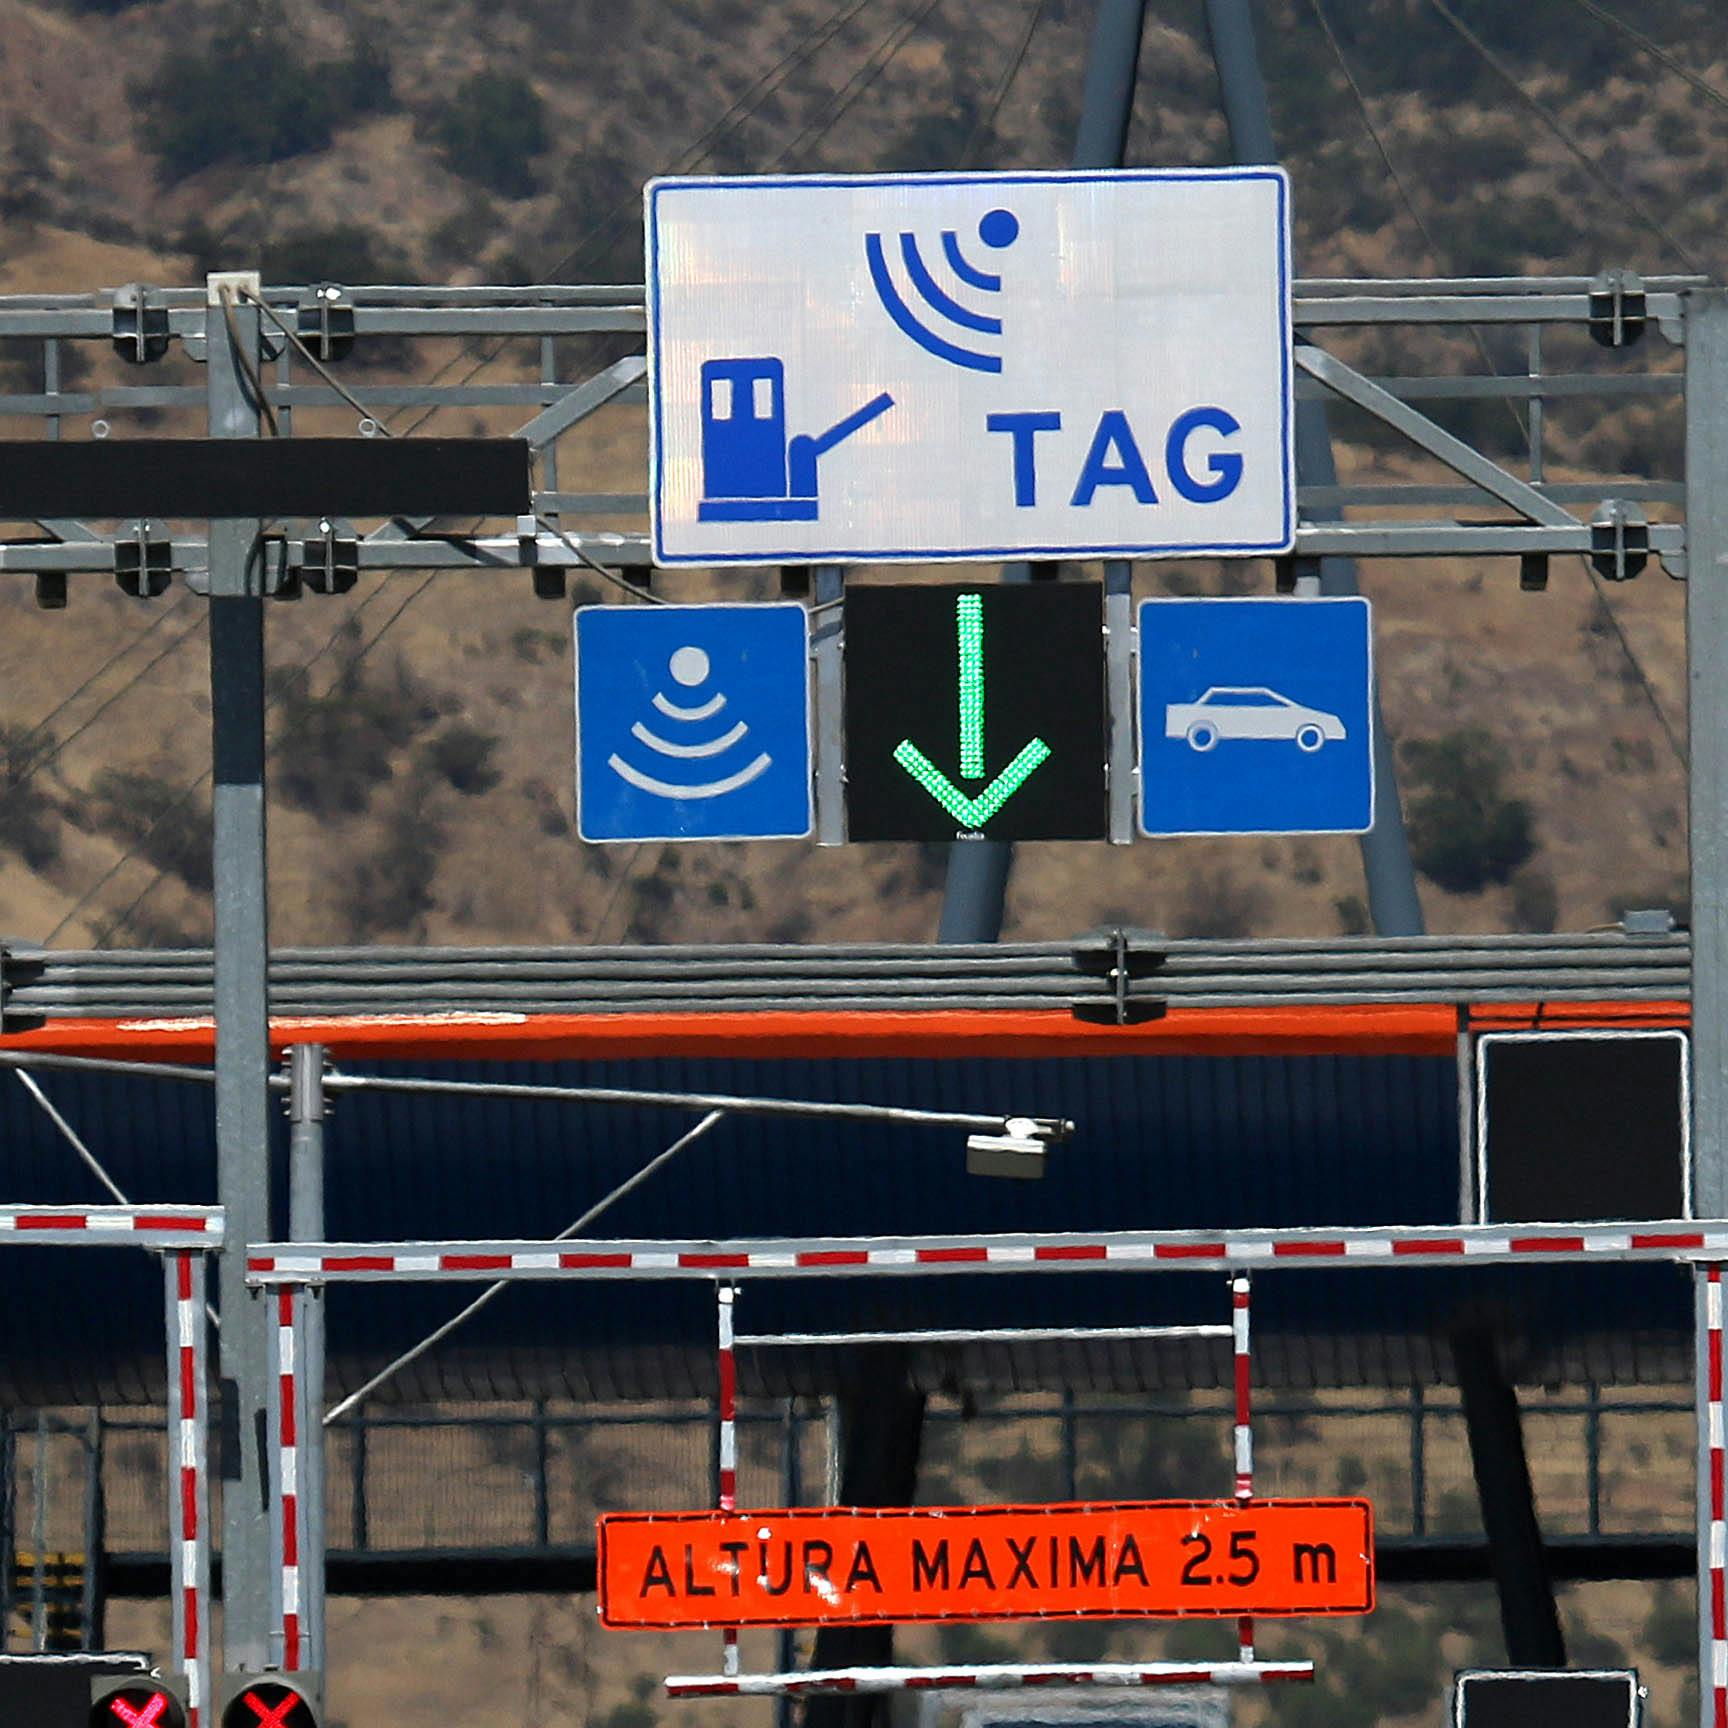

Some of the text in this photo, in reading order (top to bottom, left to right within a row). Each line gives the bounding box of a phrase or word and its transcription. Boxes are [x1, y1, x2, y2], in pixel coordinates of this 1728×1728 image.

[984, 406, 1244, 507] TAG
[638, 1530, 1337, 1599] ALTURA MAXIMA 2.5 m
